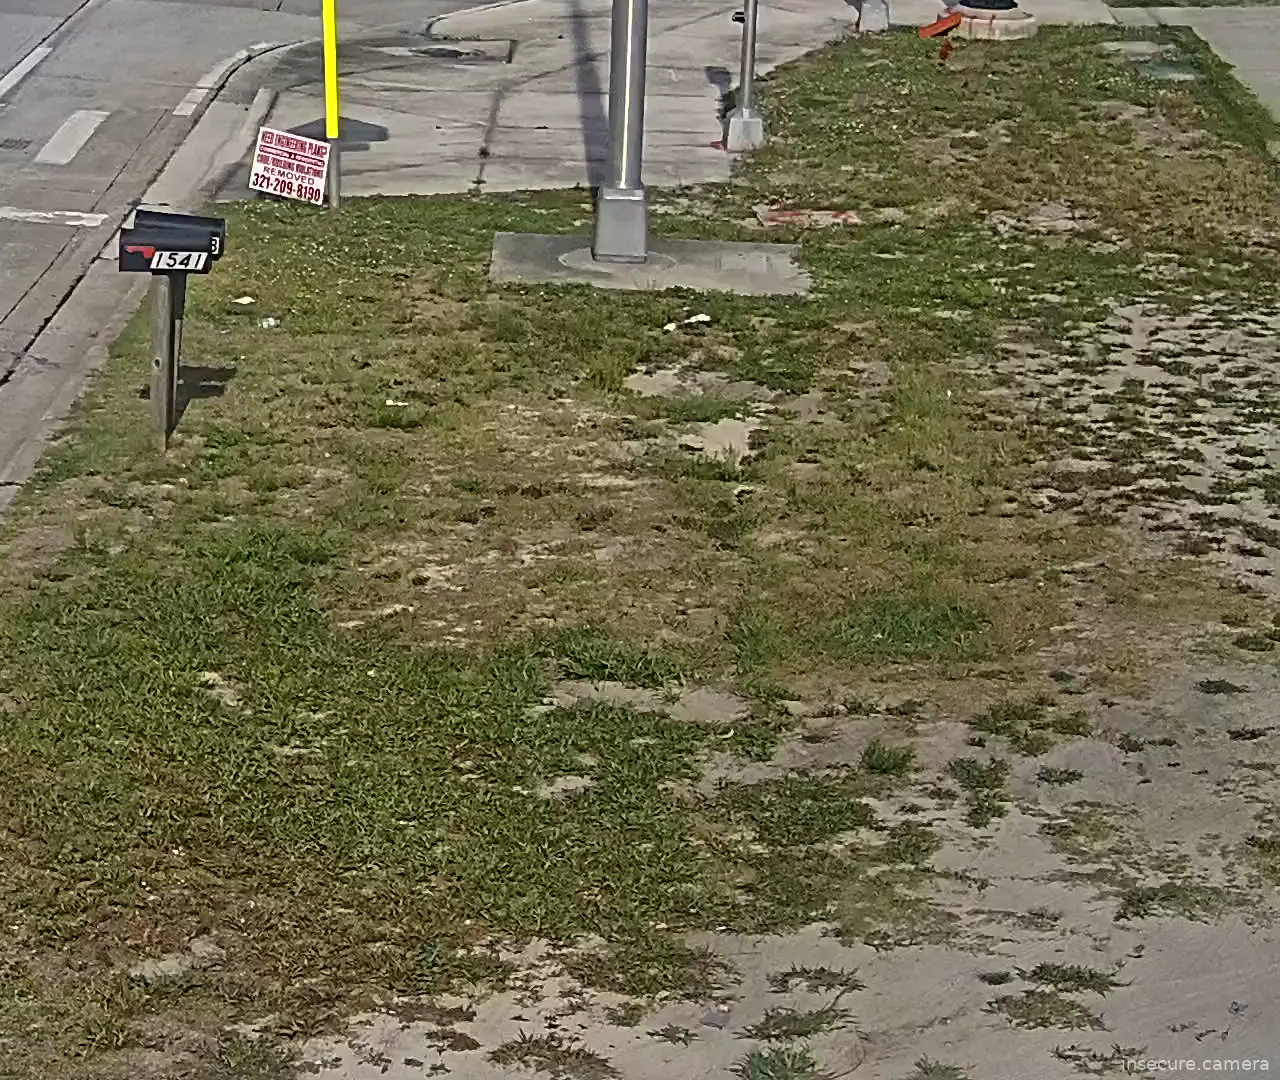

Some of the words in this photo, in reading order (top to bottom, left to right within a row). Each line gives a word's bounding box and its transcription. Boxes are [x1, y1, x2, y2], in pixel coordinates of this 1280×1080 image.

[263, 166, 315, 185] REMOVED
[252, 172, 321, 202] 321-209-8190
[155, 252, 202, 268] 1541
